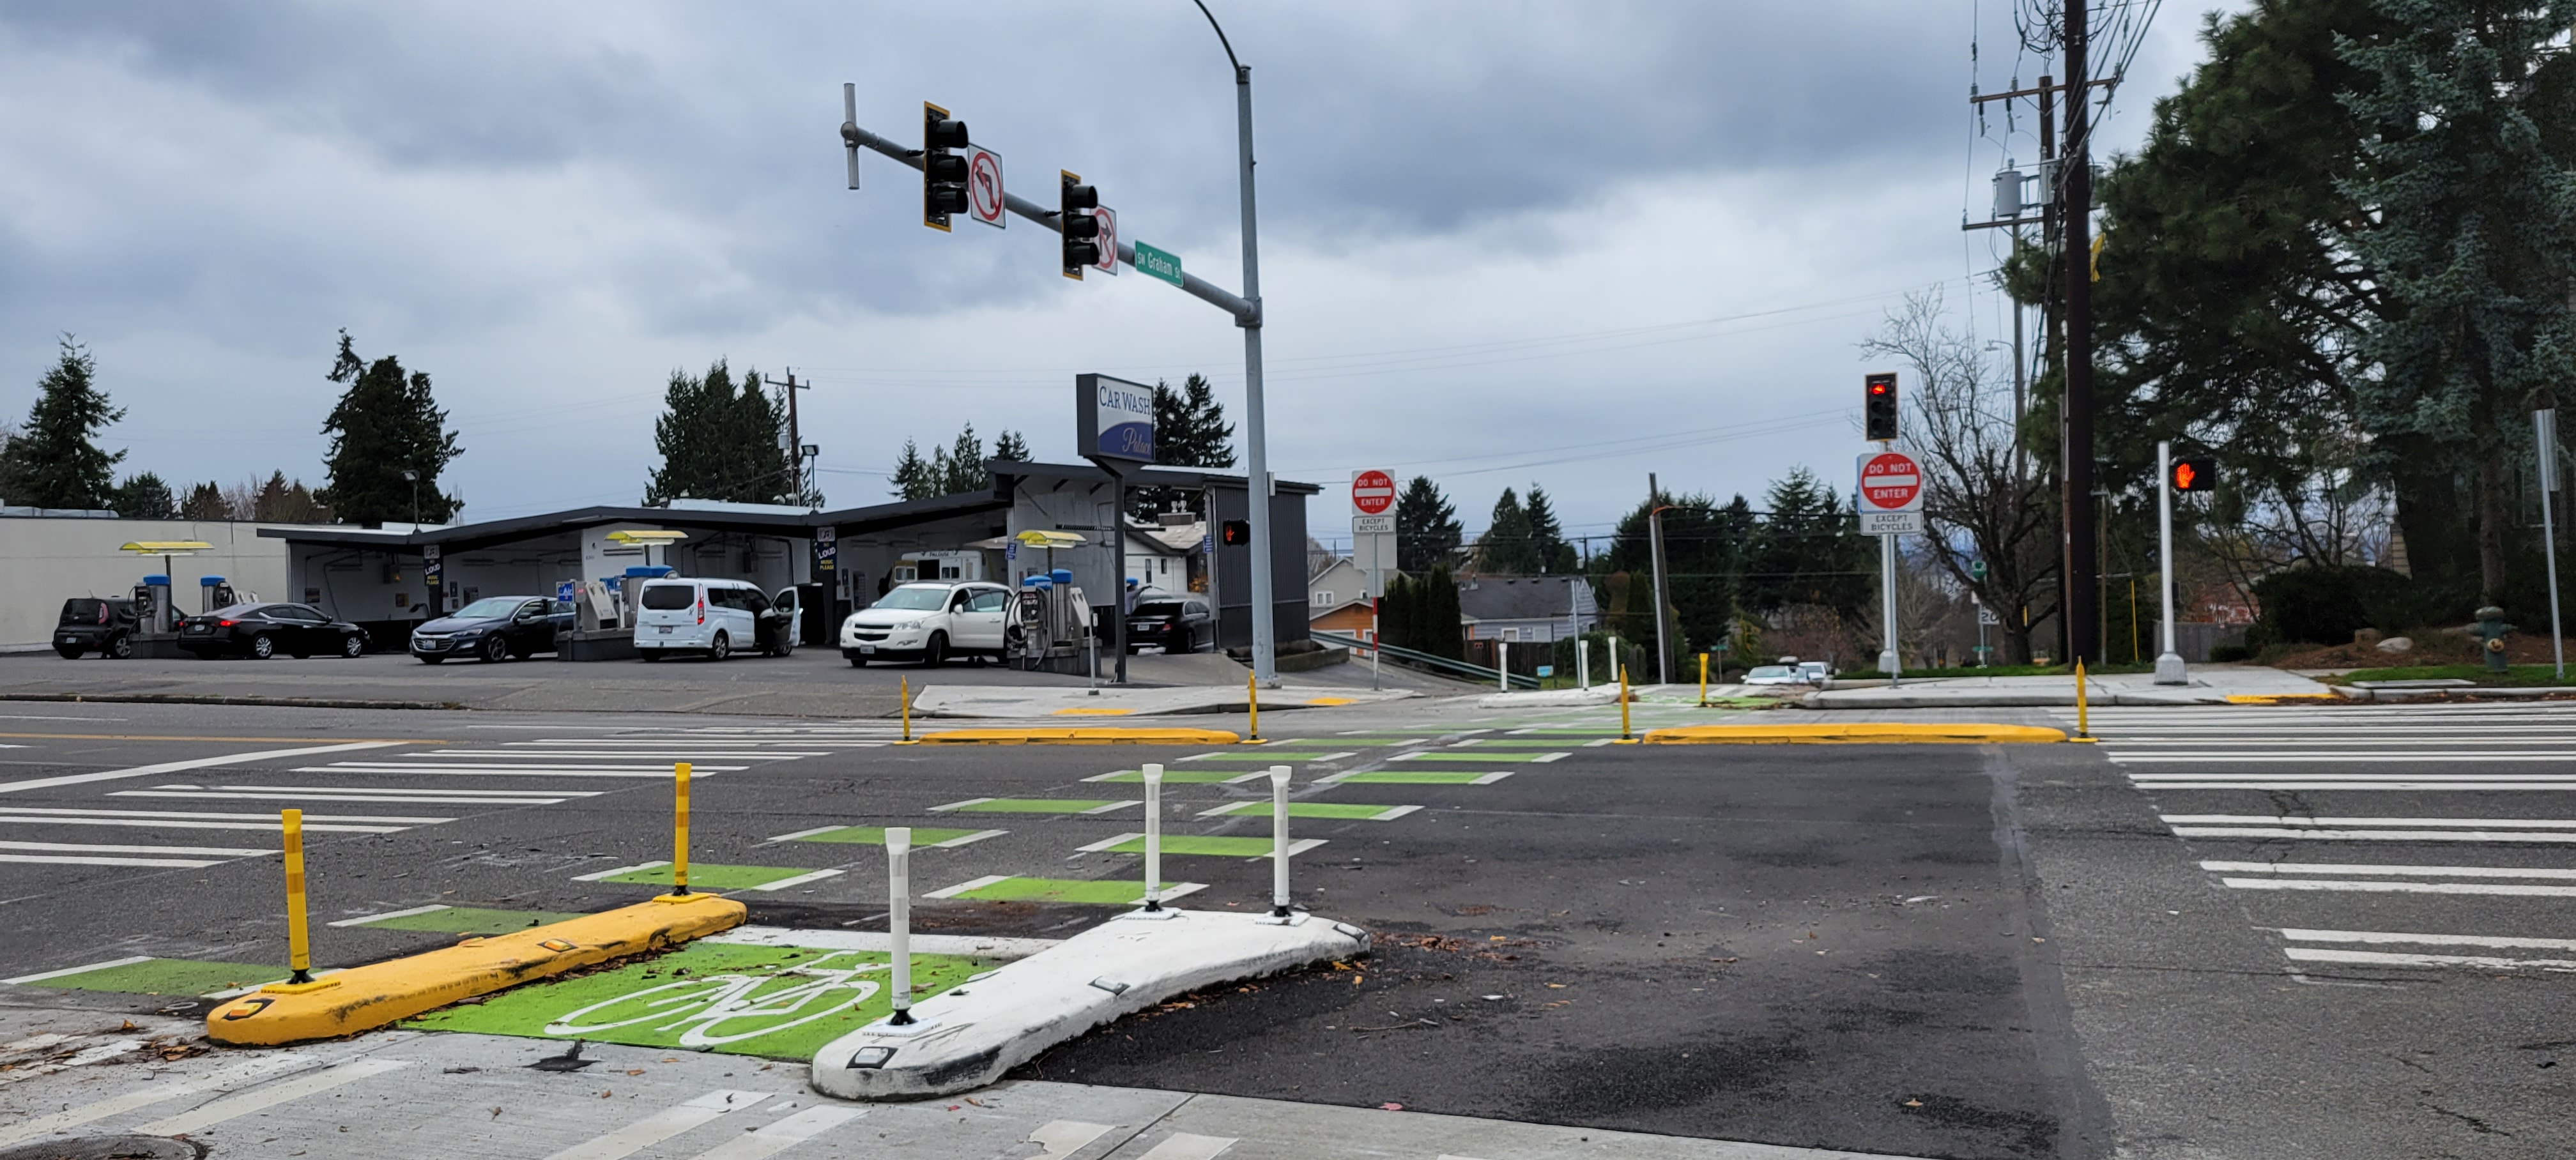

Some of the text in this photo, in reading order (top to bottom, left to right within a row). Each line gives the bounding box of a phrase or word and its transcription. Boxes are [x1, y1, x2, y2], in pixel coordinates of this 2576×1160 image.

[1138, 252, 1181, 279] SW Graham St
[1100, 386, 1151, 415] CAR WASH
[1123, 427, 1150, 454] Palace
[1868, 462, 1911, 474] DO NOT
[1372, 478, 1388, 486] NOT
[1873, 489, 1908, 499] ENTER
[1361, 498, 1385, 507] ENTER
[1871, 523, 1913, 531] BICYCLES
[818, 547, 836, 560] LOUD
[425, 563, 440, 575] LOUD
[1981, 611, 1999, 622] 20
